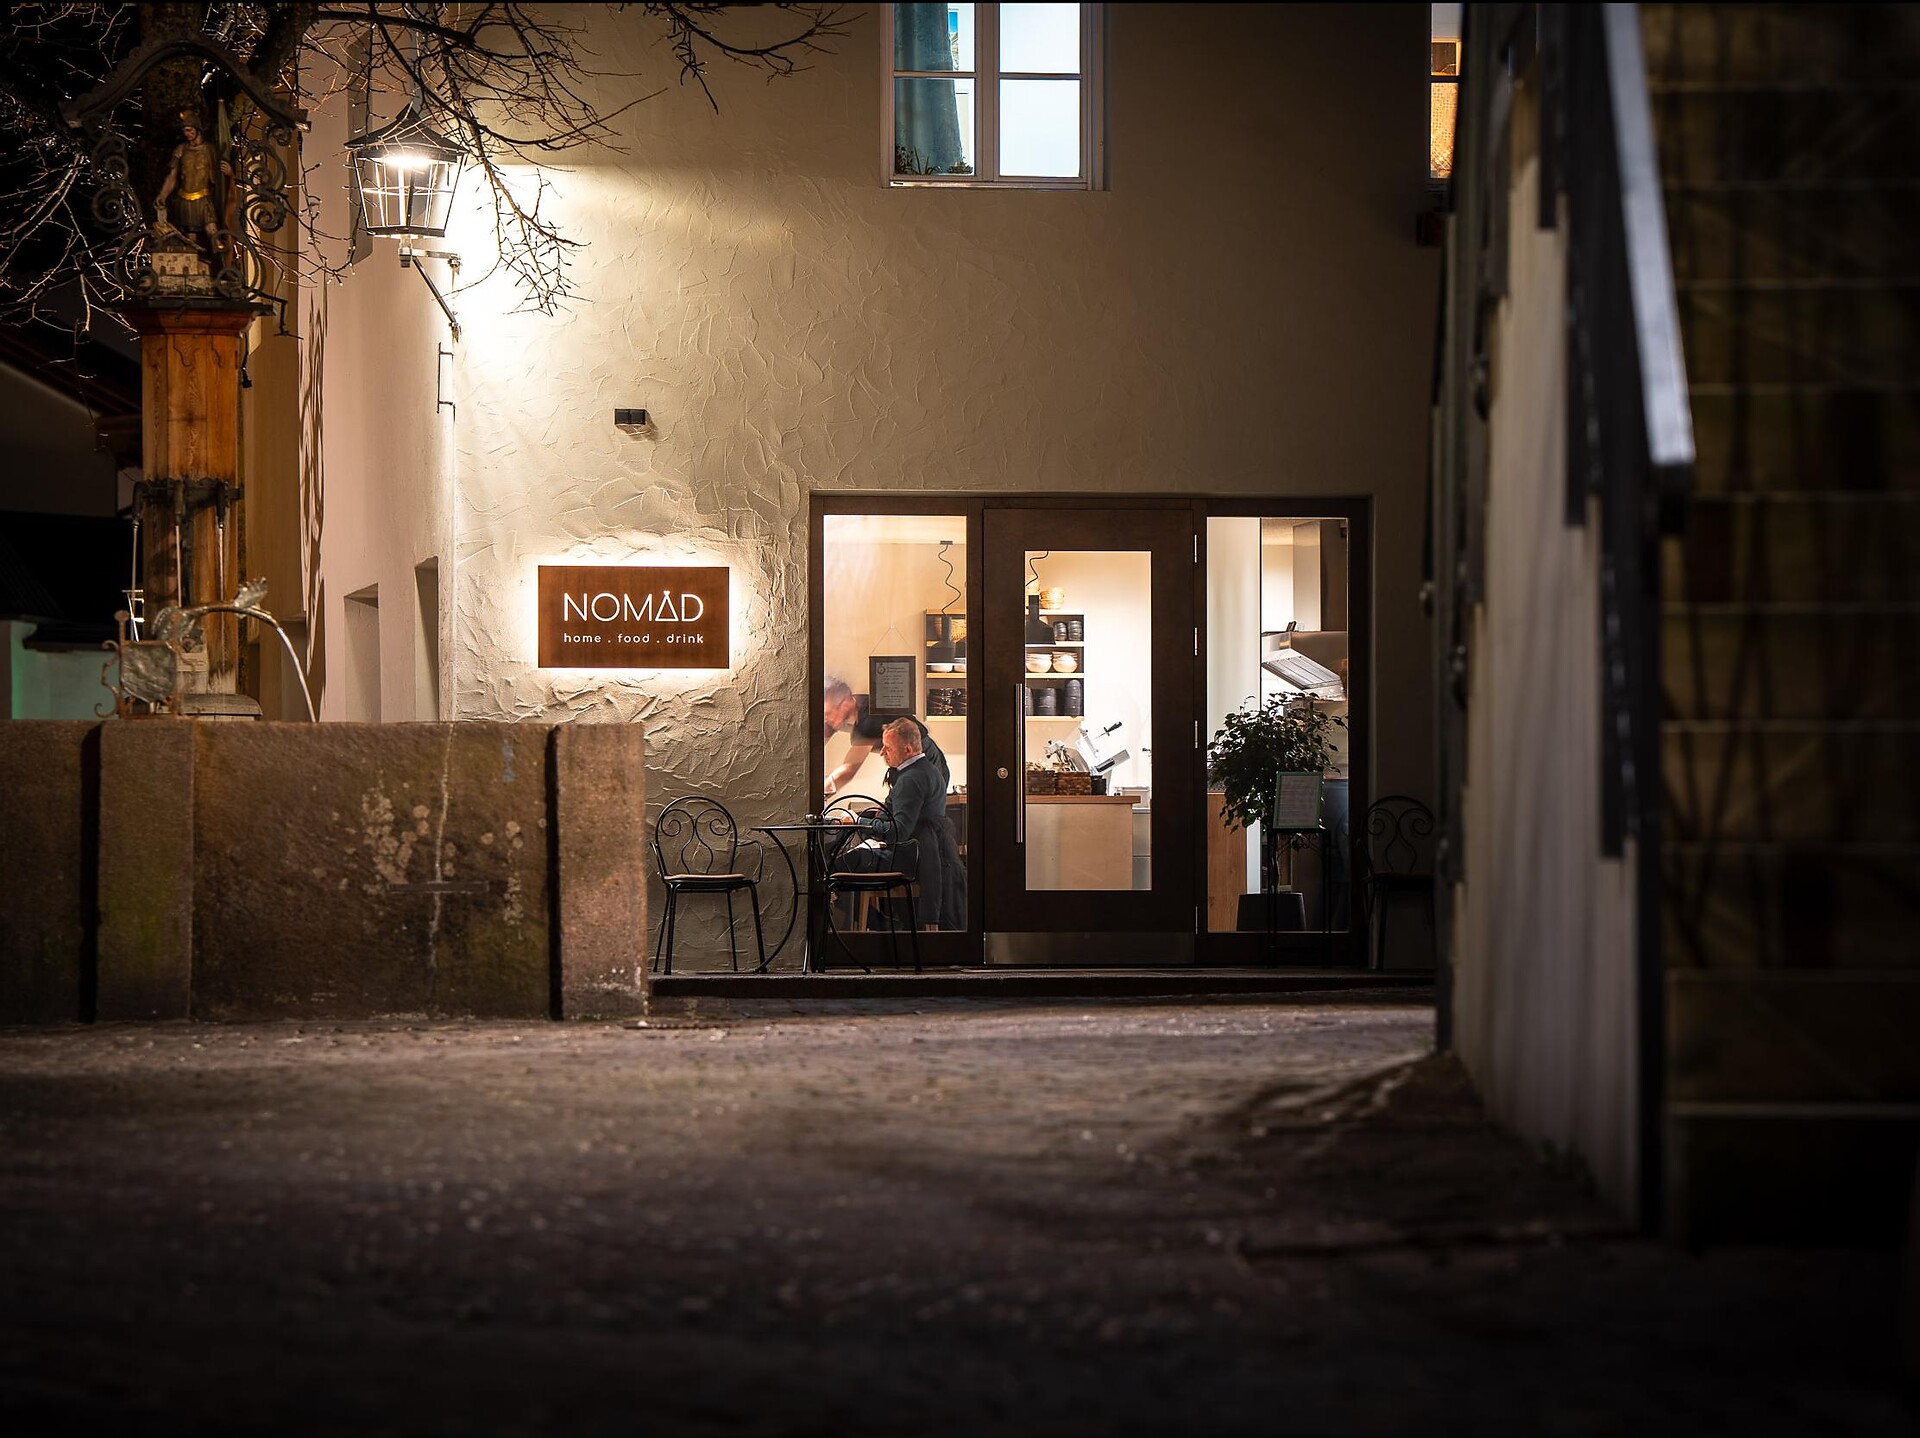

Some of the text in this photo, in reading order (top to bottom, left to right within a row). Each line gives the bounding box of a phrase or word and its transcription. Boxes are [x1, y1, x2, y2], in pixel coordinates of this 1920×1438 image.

[563, 632, 704, 644] home food drink
